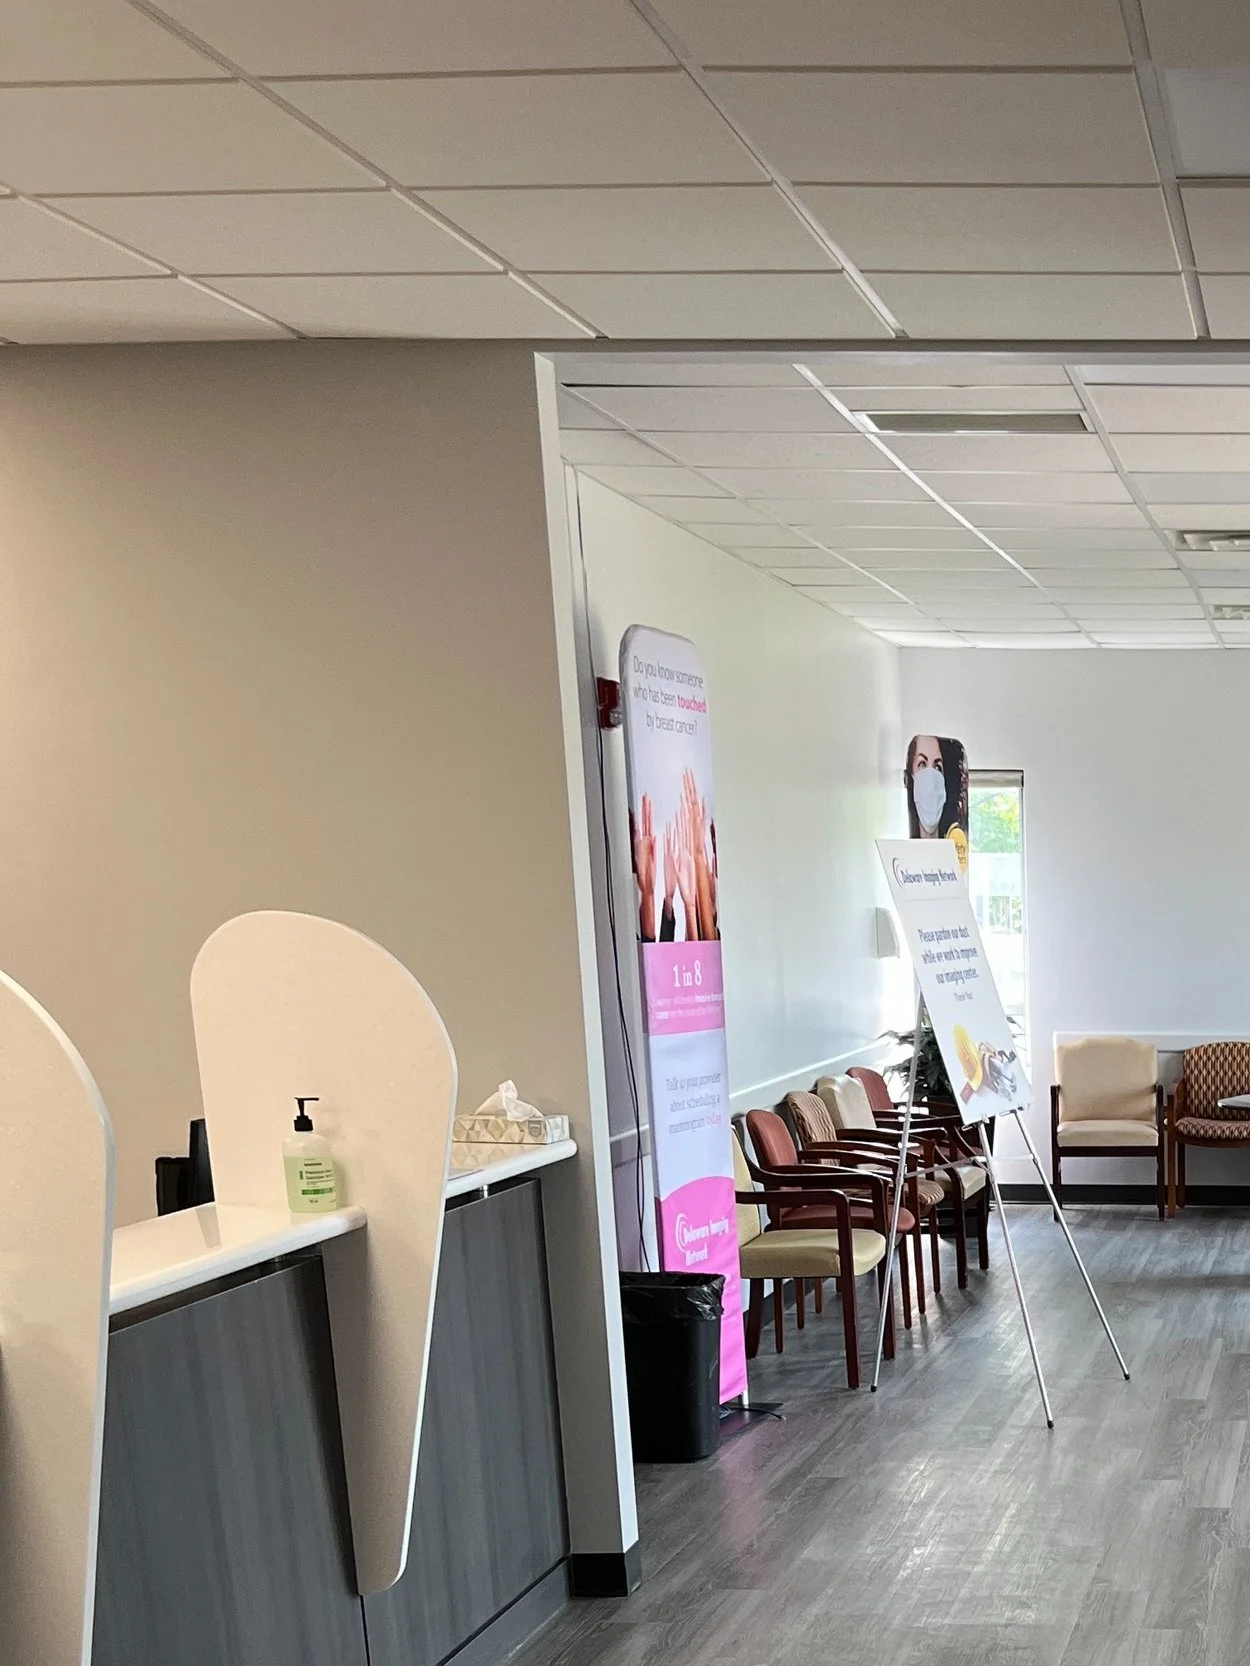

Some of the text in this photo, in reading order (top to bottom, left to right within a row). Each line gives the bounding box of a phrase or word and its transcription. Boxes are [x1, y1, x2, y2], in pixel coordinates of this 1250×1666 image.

[633, 656, 704, 689] Do you know someone
[633, 683, 707, 713] who has been touched
[645, 710, 698, 736] by breast cancer?
[900, 868, 958, 887] Delaware Imaging Network
[917, 928, 935, 943] Please
[934, 926, 951, 944] pardon
[921, 949, 937, 964] while
[943, 946, 956, 961] work
[672, 959, 703, 988] 1 in 8
[944, 968, 966, 985] imaging
[683, 1217, 729, 1244] Delaware Imaging
[685, 1243, 708, 1267] Network
